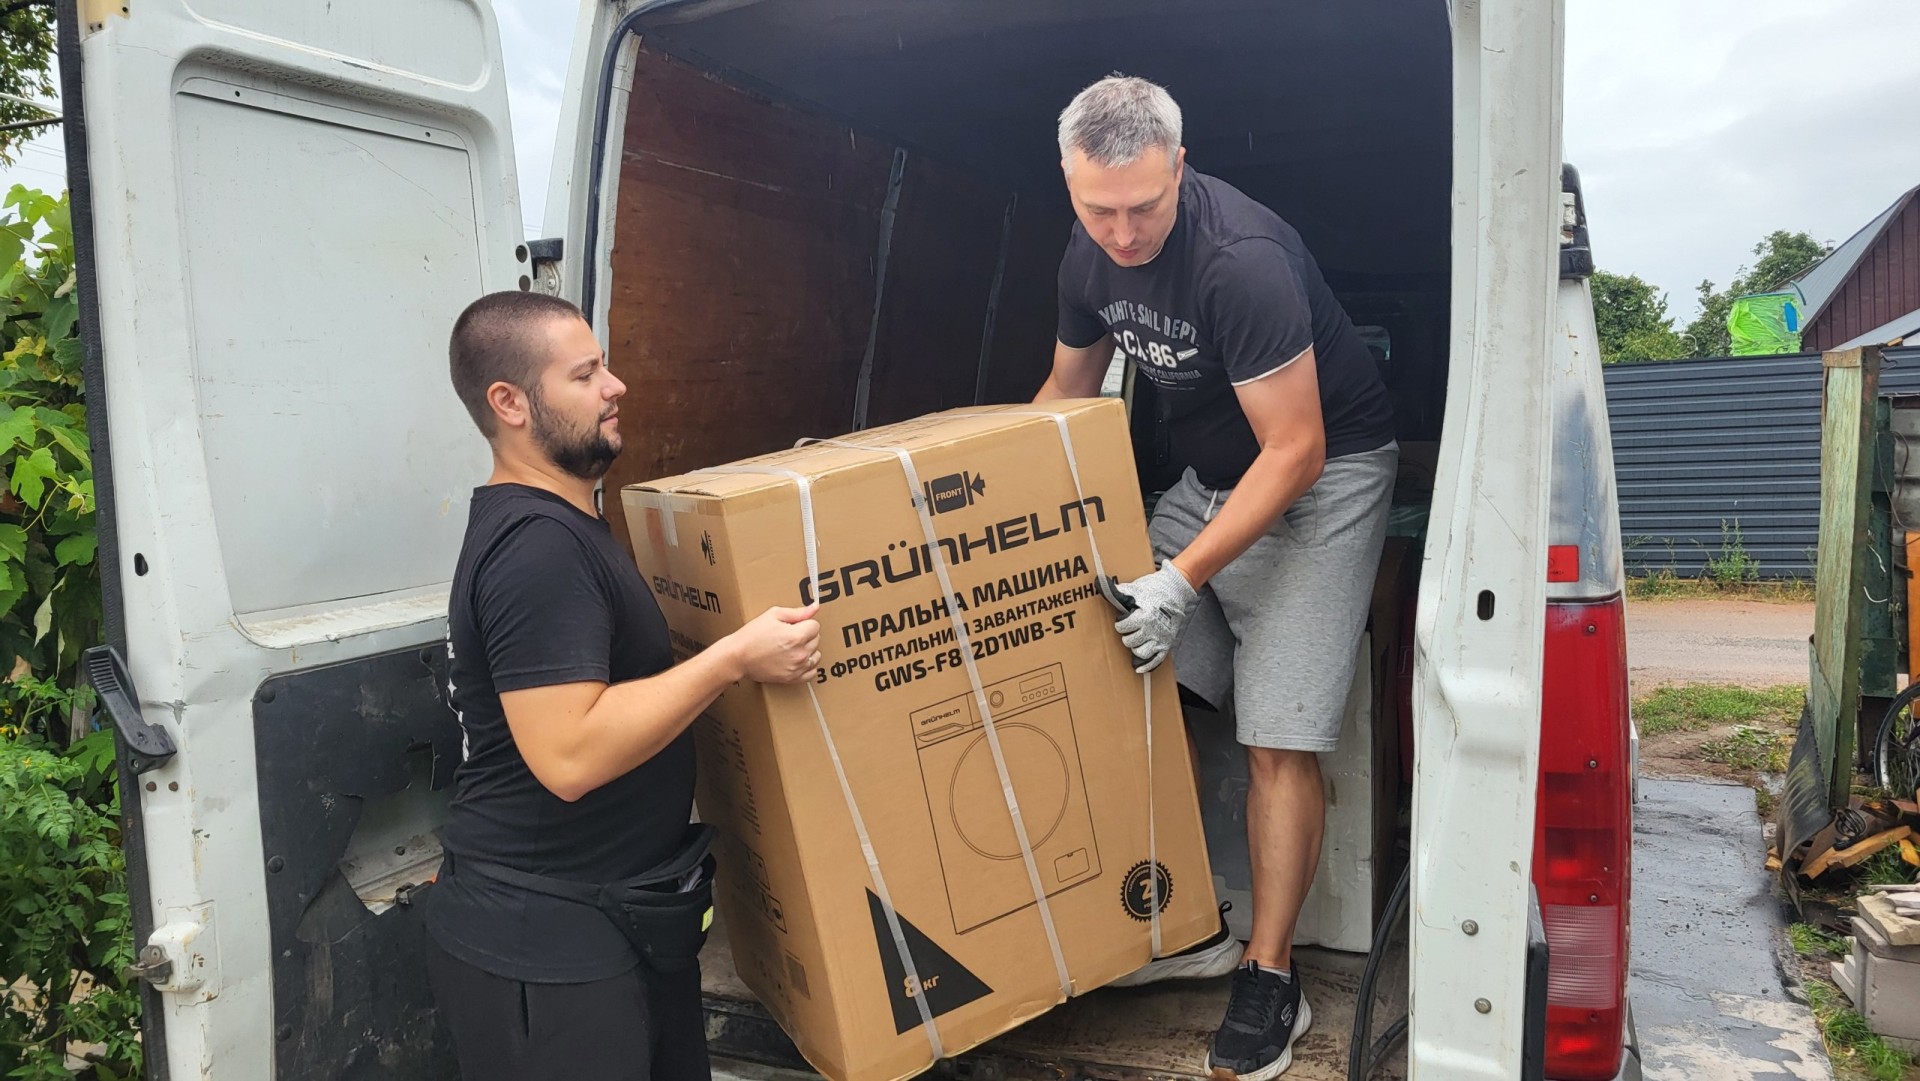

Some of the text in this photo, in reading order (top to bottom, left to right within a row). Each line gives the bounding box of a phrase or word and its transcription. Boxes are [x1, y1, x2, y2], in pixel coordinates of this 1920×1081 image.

[1137, 303, 1161, 332] SAIL
[935, 487, 962, 501] FRONT
[798, 495, 1106, 606] GRÜNHELM
[652, 575, 722, 614] GRÜNHELM
[842, 555, 1089, 648] ПРАЛЬНА МАШИНА
[972, 575, 1119, 634] ЗАВАНТАЖЕНН
[874, 610, 1078, 692] GWS-F82D1WB-ST
[920, 708, 961, 726] GRÜNHELM
[903, 974, 920, 998] 8
